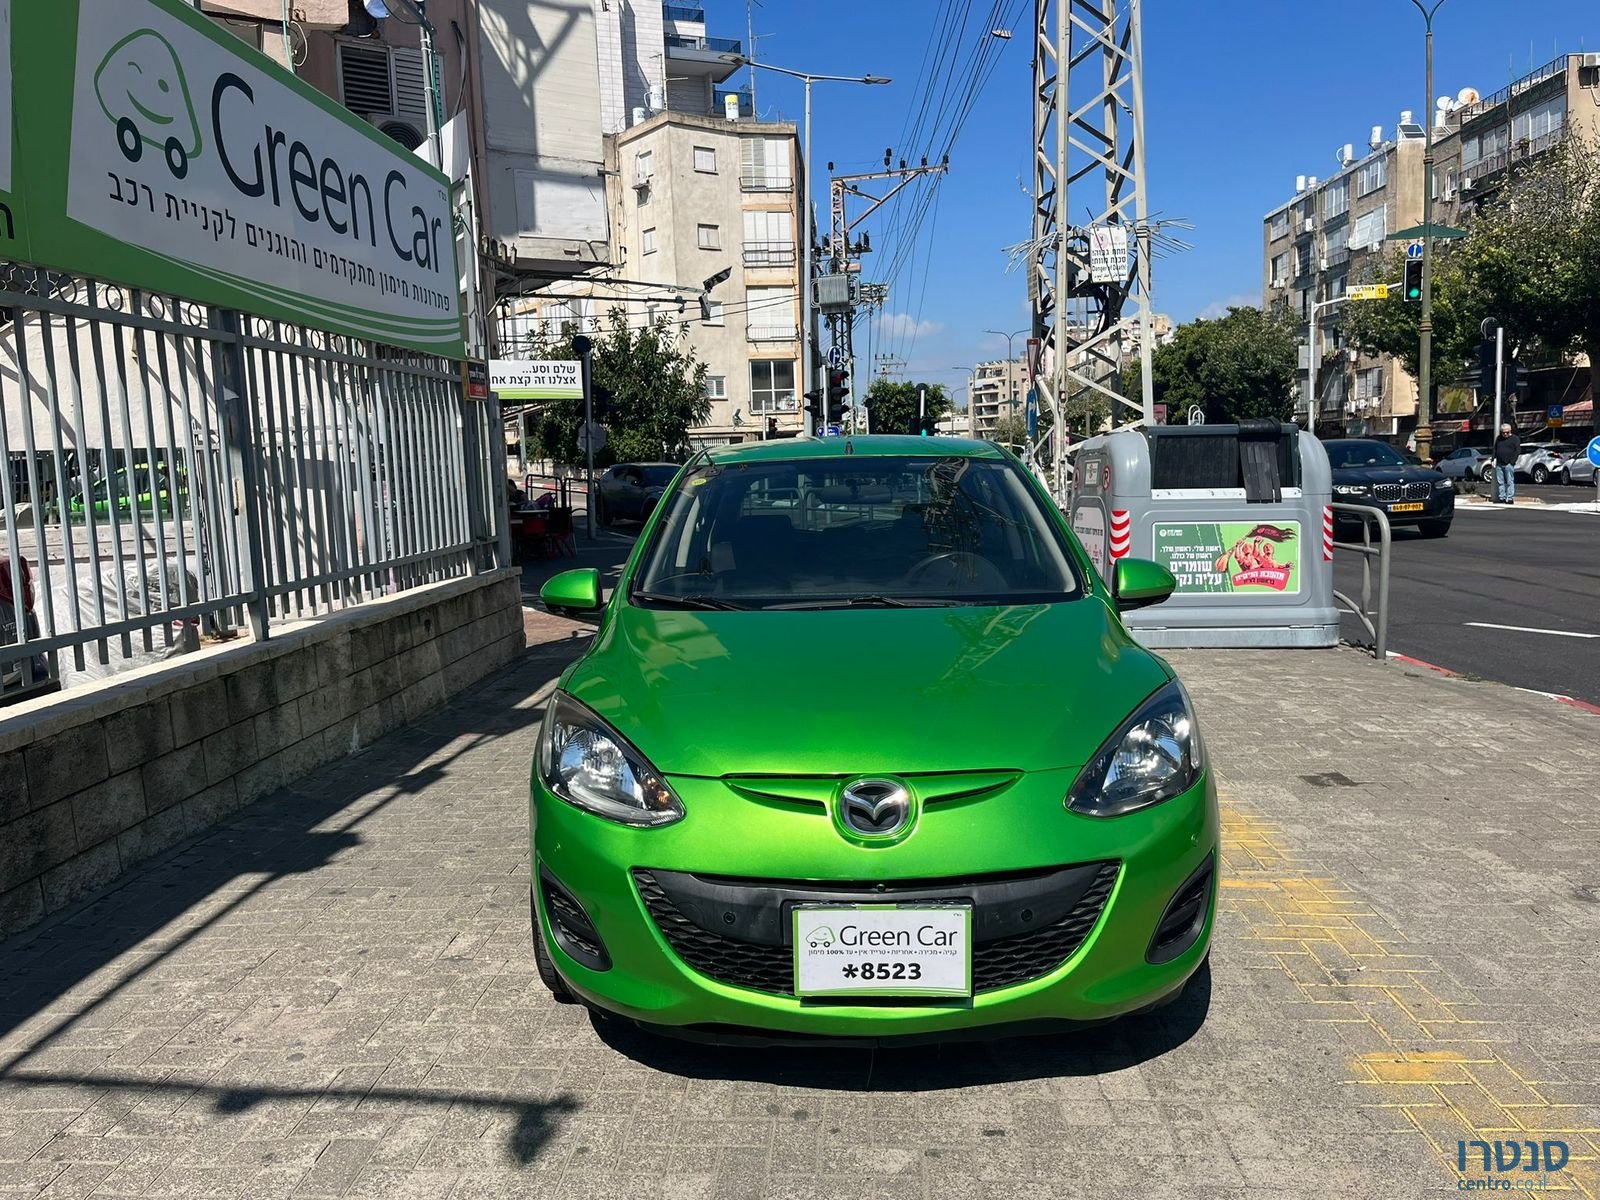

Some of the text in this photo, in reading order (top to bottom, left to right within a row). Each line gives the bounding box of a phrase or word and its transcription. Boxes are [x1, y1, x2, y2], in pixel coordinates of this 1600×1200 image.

[211, 72, 442, 274] Green Car
[107, 171, 451, 312] פתרונות מימון מתקדמים והוגנים לקניית רכב
[1378, 287, 1385, 295] 13
[522, 363, 576, 374] שלם וסע...
[489, 374, 577, 386] אצלנו זה קצת אח
[1170, 561, 1213, 572] שומרים
[1195, 572, 1222, 586] עליה
[840, 925, 958, 947] Green Car
